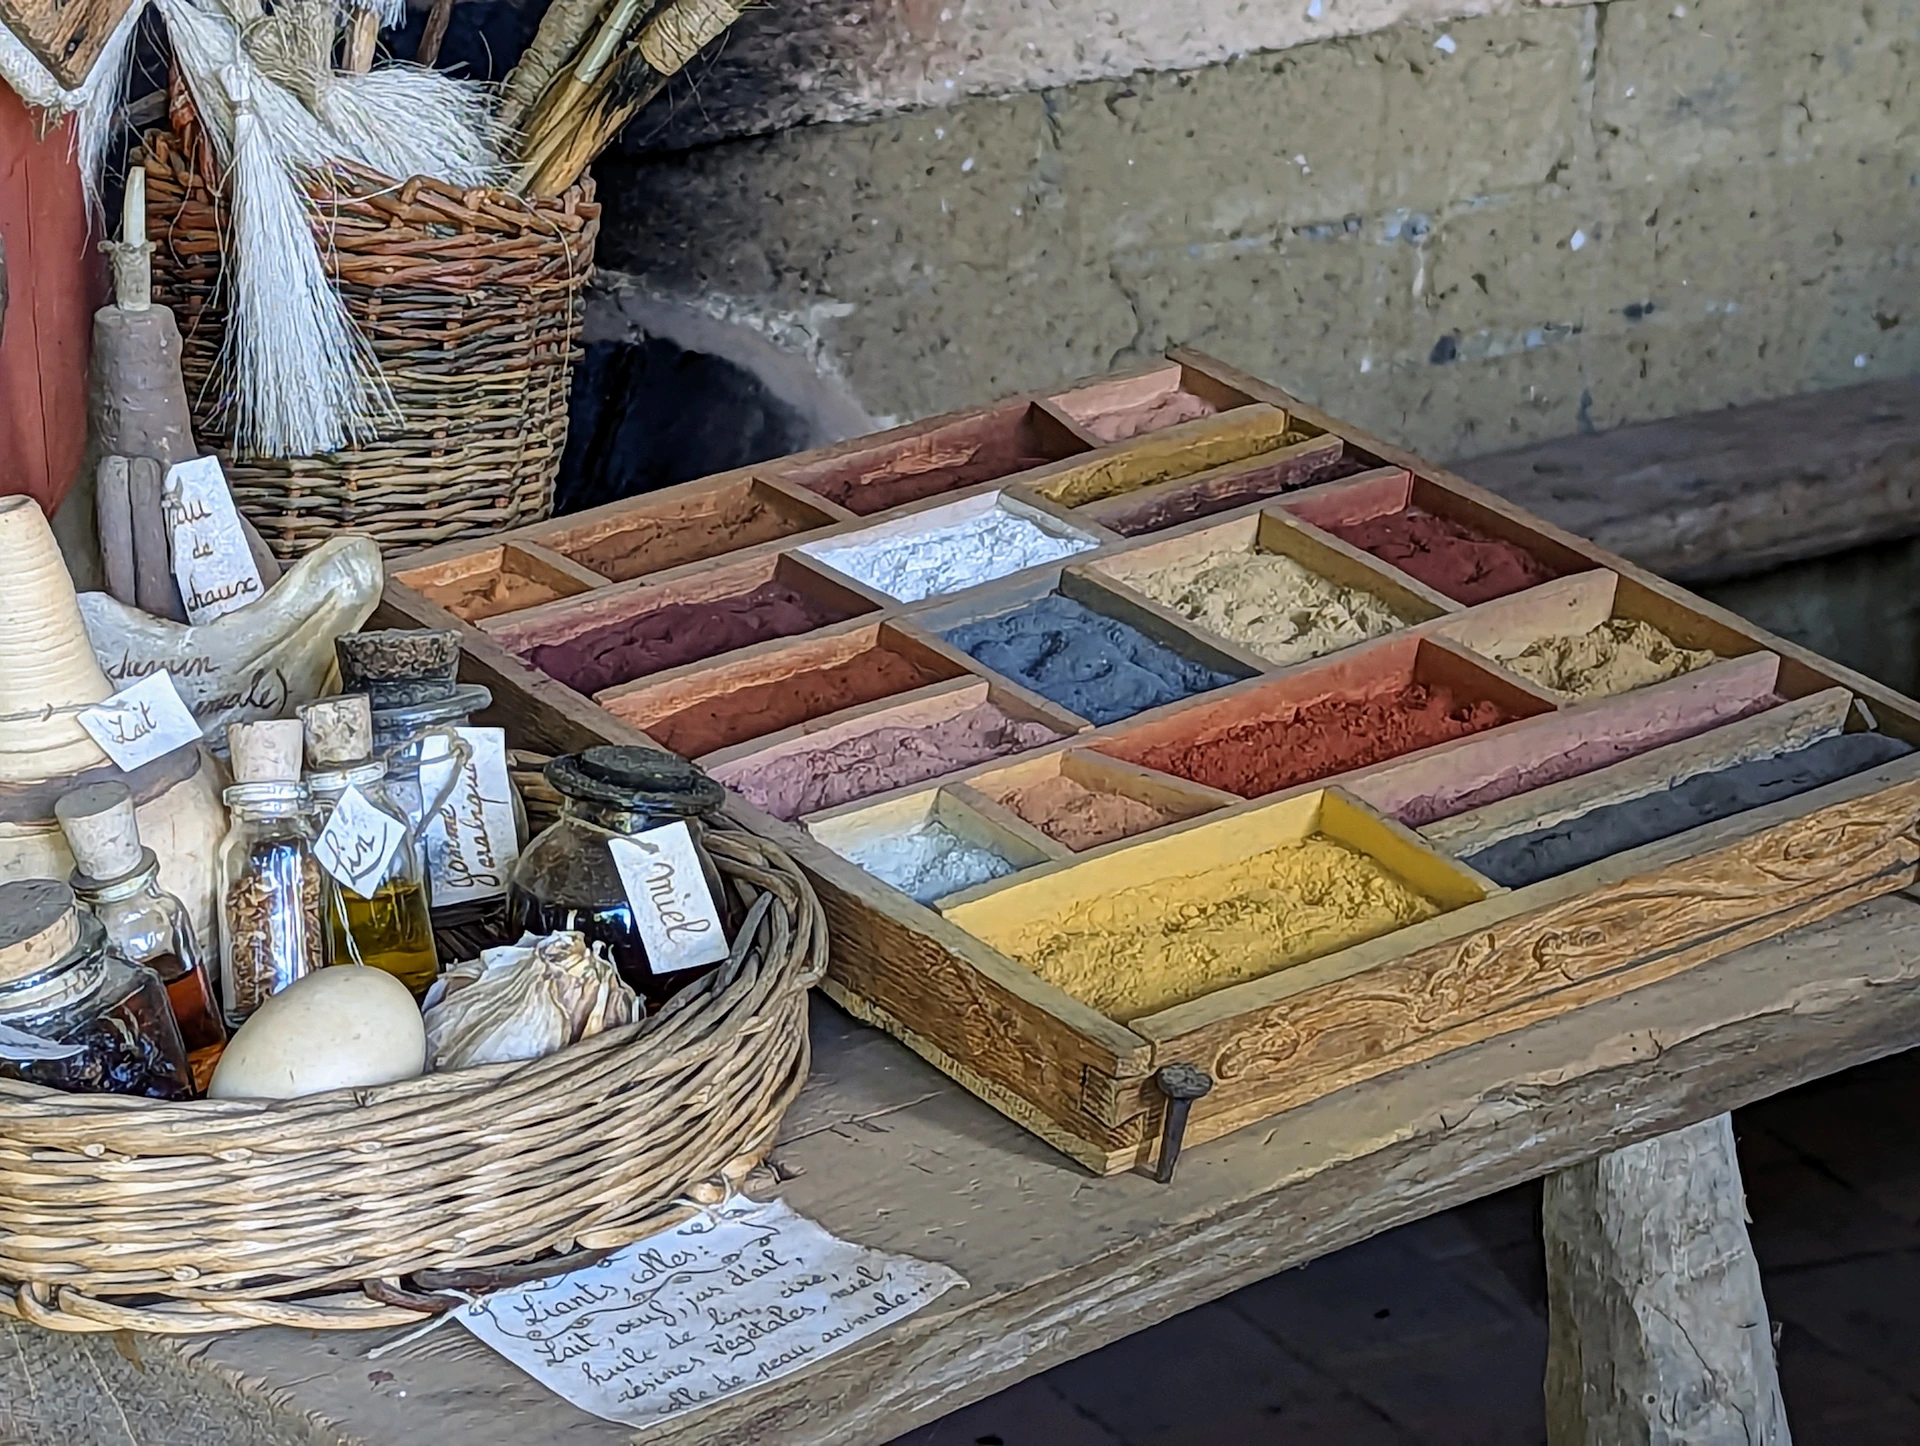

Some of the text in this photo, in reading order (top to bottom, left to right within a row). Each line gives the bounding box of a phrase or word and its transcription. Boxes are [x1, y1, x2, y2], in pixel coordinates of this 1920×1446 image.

[192, 534, 214, 560] de
[187, 573, 259, 612] chaux
[108, 701, 157, 744] Lait
[581, 1346, 659, 1386] huile
[664, 1331, 697, 1350] de
[711, 1372, 747, 1393] de
[755, 1344, 816, 1379] peau
